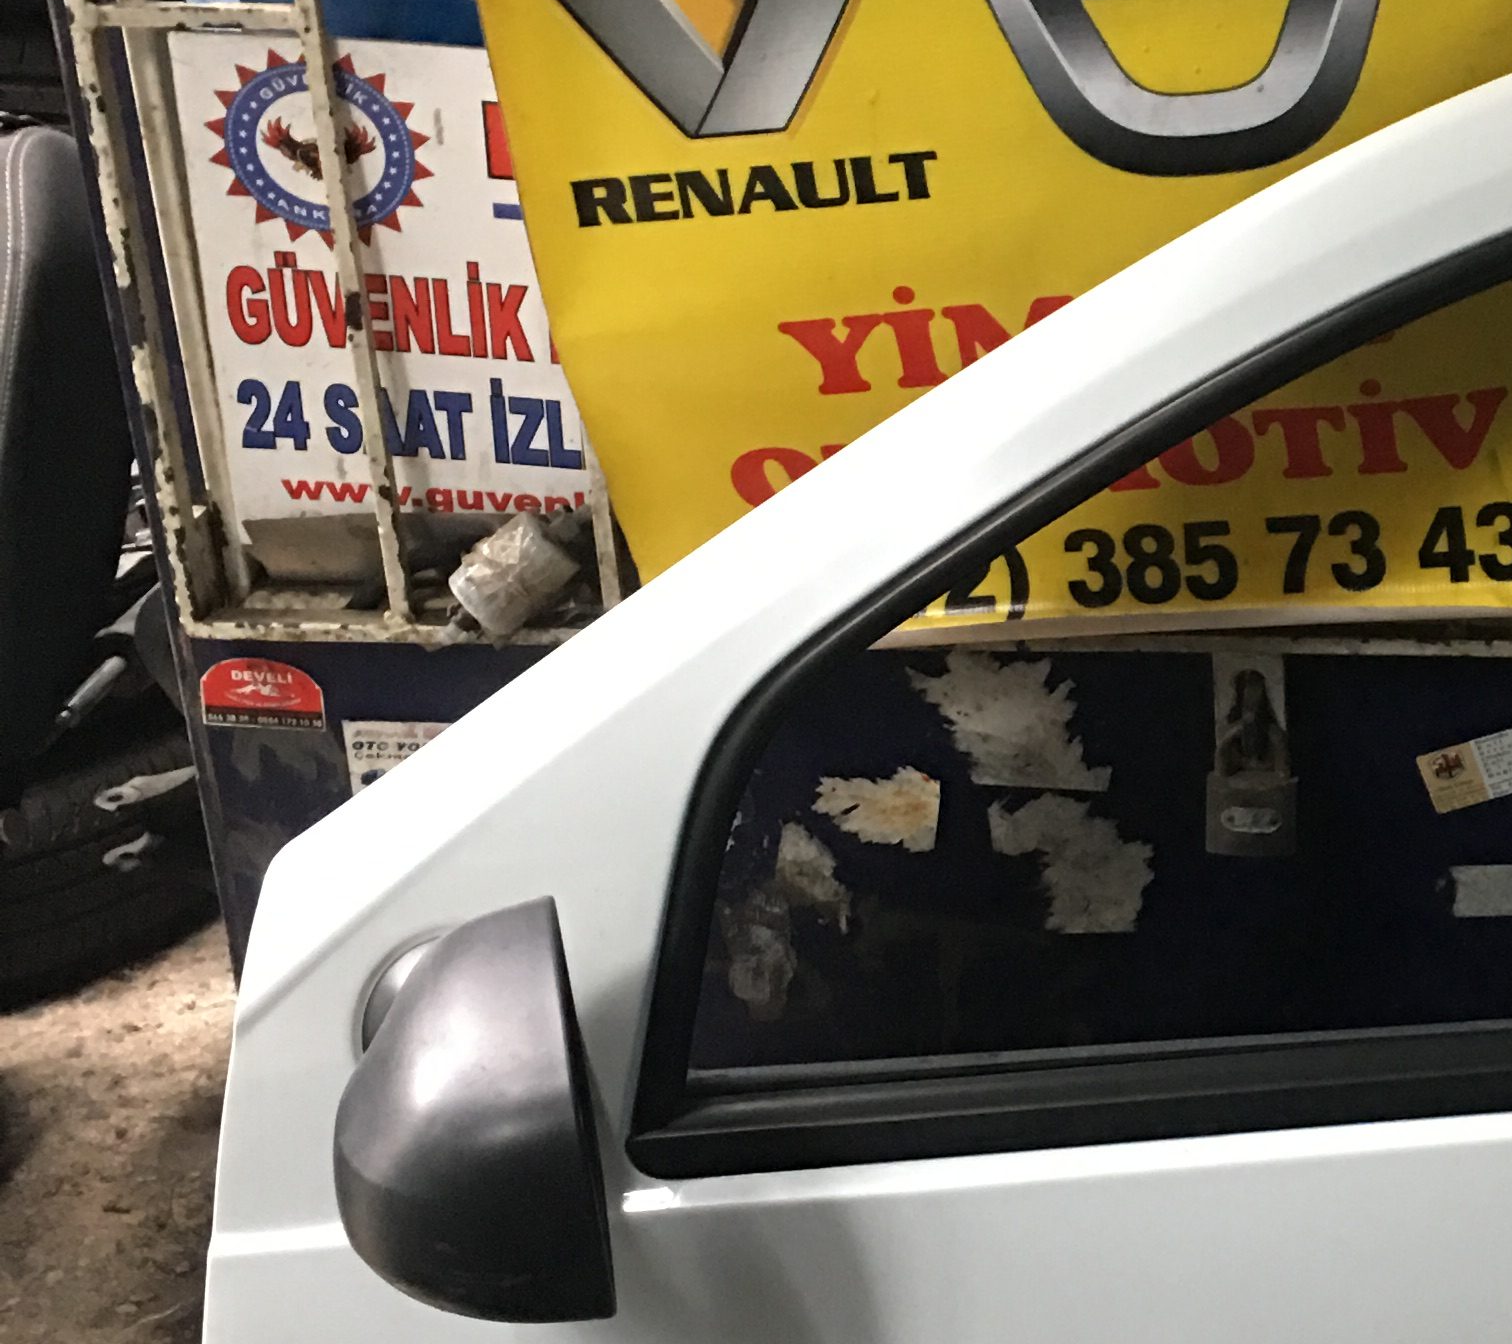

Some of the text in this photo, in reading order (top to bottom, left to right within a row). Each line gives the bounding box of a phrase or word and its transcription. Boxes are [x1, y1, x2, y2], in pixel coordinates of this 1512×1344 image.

[570, 150, 938, 227] RENAULT
[226, 251, 535, 362] GÜVENLİK
[237, 379, 310, 450] 24
[1063, 521, 1238, 608] 385
[1264, 509, 1387, 594] 73
[231, 669, 293, 684] DEVELİ
